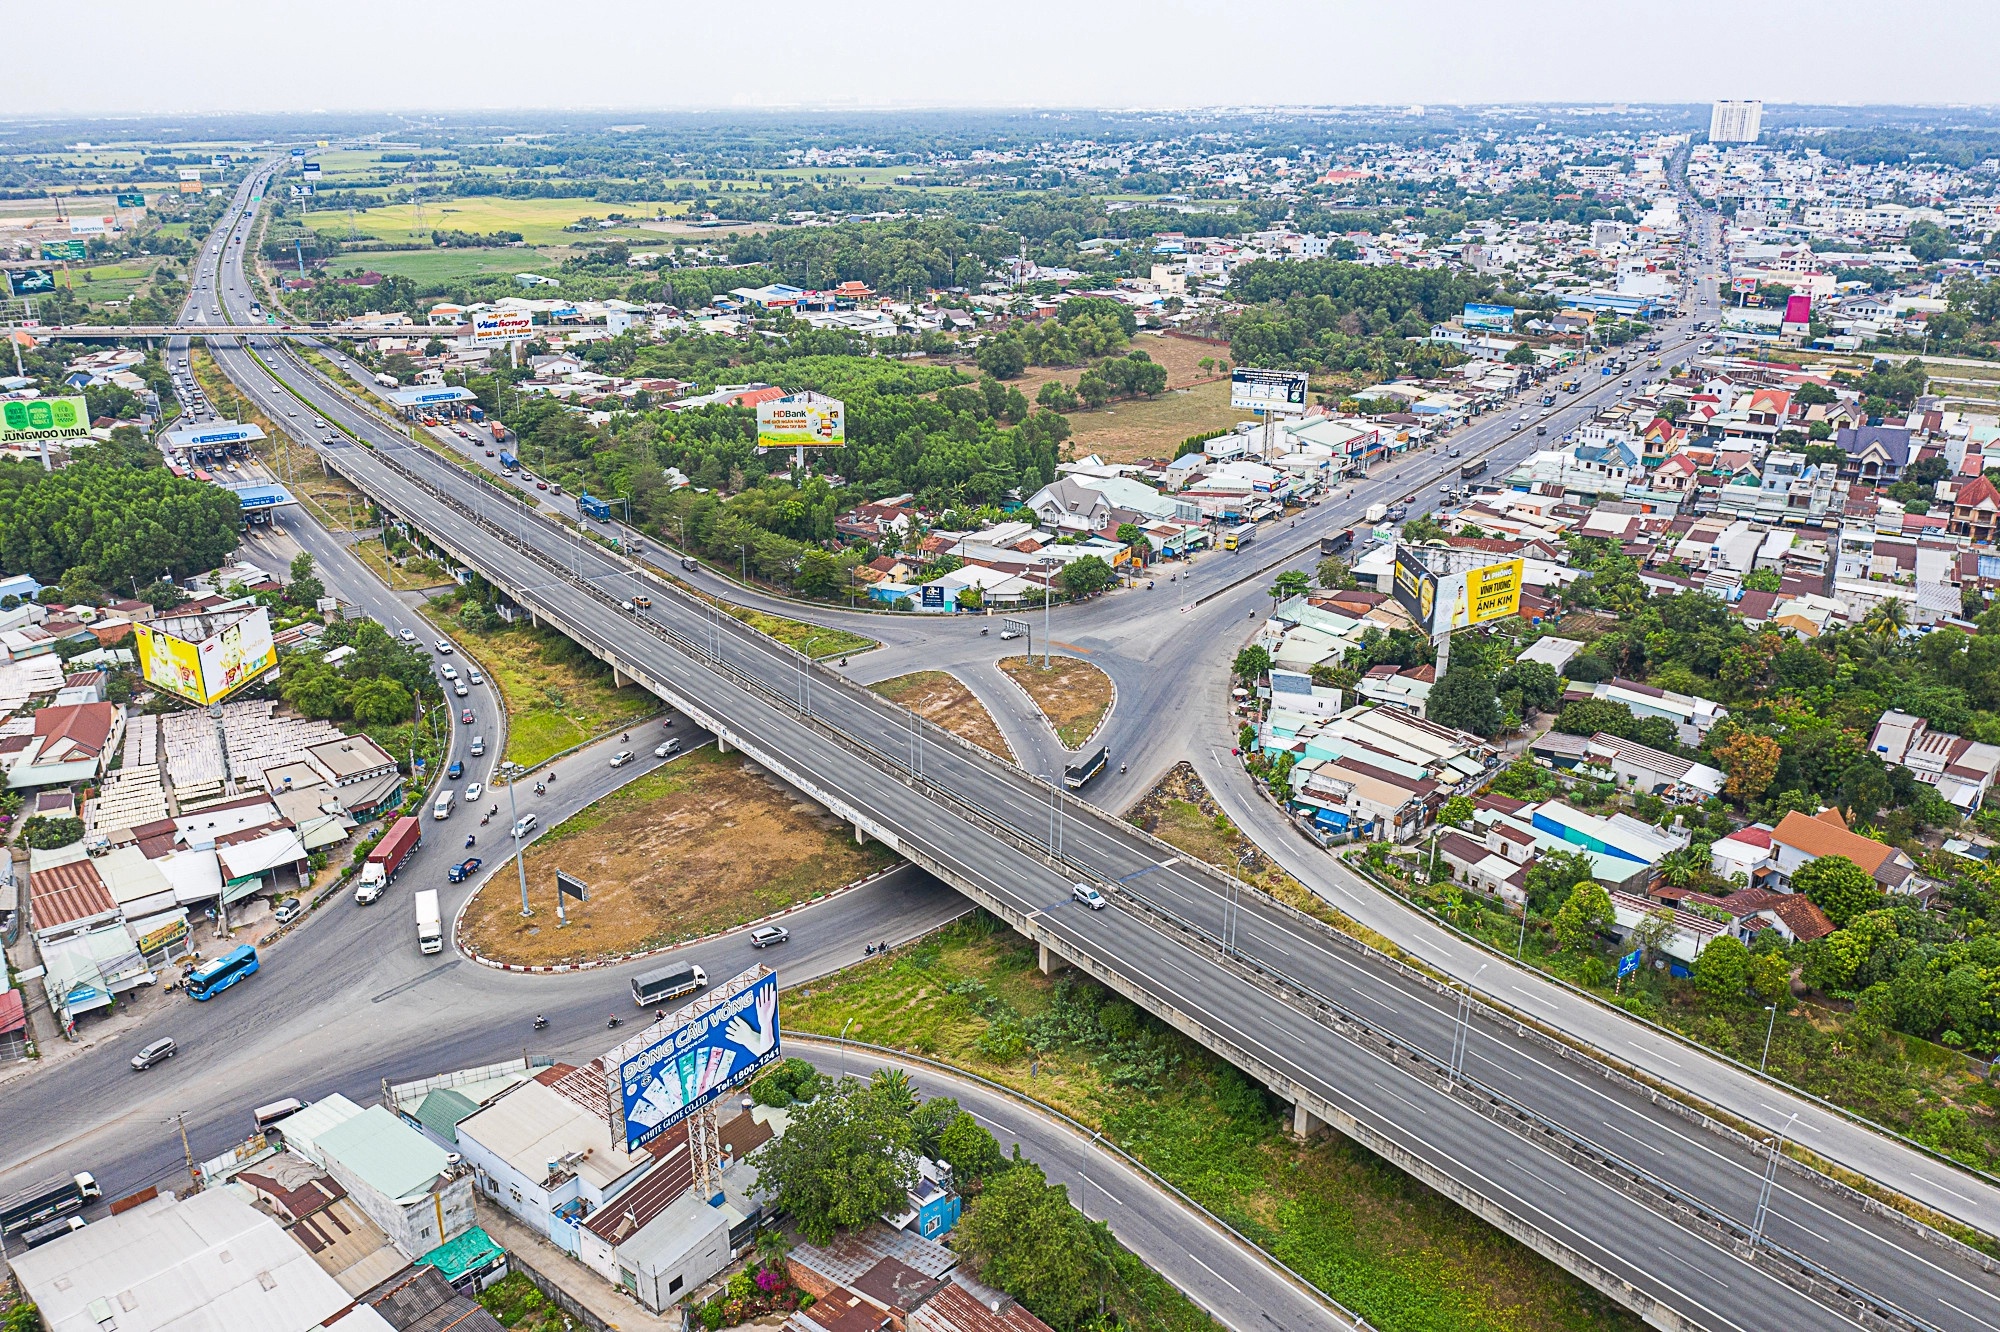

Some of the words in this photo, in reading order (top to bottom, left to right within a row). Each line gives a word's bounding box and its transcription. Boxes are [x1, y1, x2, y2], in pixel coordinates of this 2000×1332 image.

[773, 410, 806, 418] HDBank
[2, 430, 59, 441] JUNGWOO
[60, 427, 87, 437] VINA
[1497, 594, 1513, 606] KIM
[715, 1077, 734, 1094] Tel:
[733, 1046, 780, 1082] 1800-1241
[640, 1125, 663, 1143] WHITE
[662, 1109, 685, 1129] GLOVE
